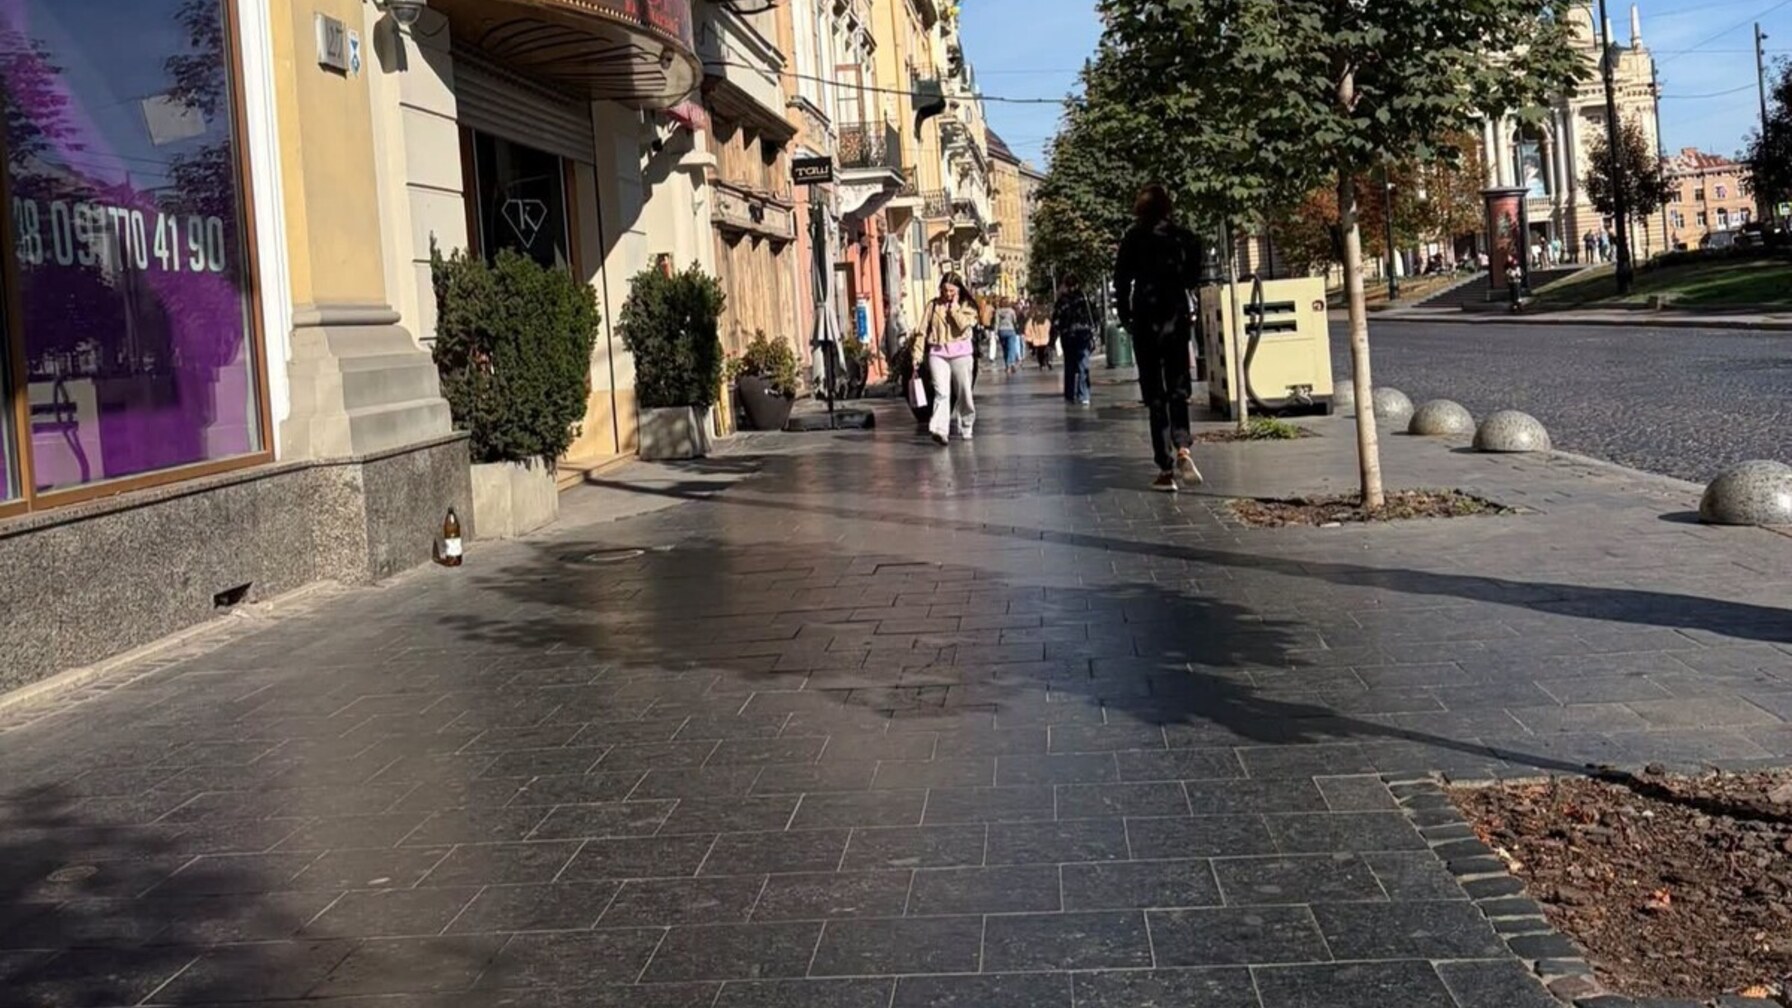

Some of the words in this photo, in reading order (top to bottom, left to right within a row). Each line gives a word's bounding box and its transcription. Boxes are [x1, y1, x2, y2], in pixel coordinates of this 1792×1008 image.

[327, 26, 343, 59] 27
[153, 212, 180, 272] 41
[188, 215, 226, 273] 90
